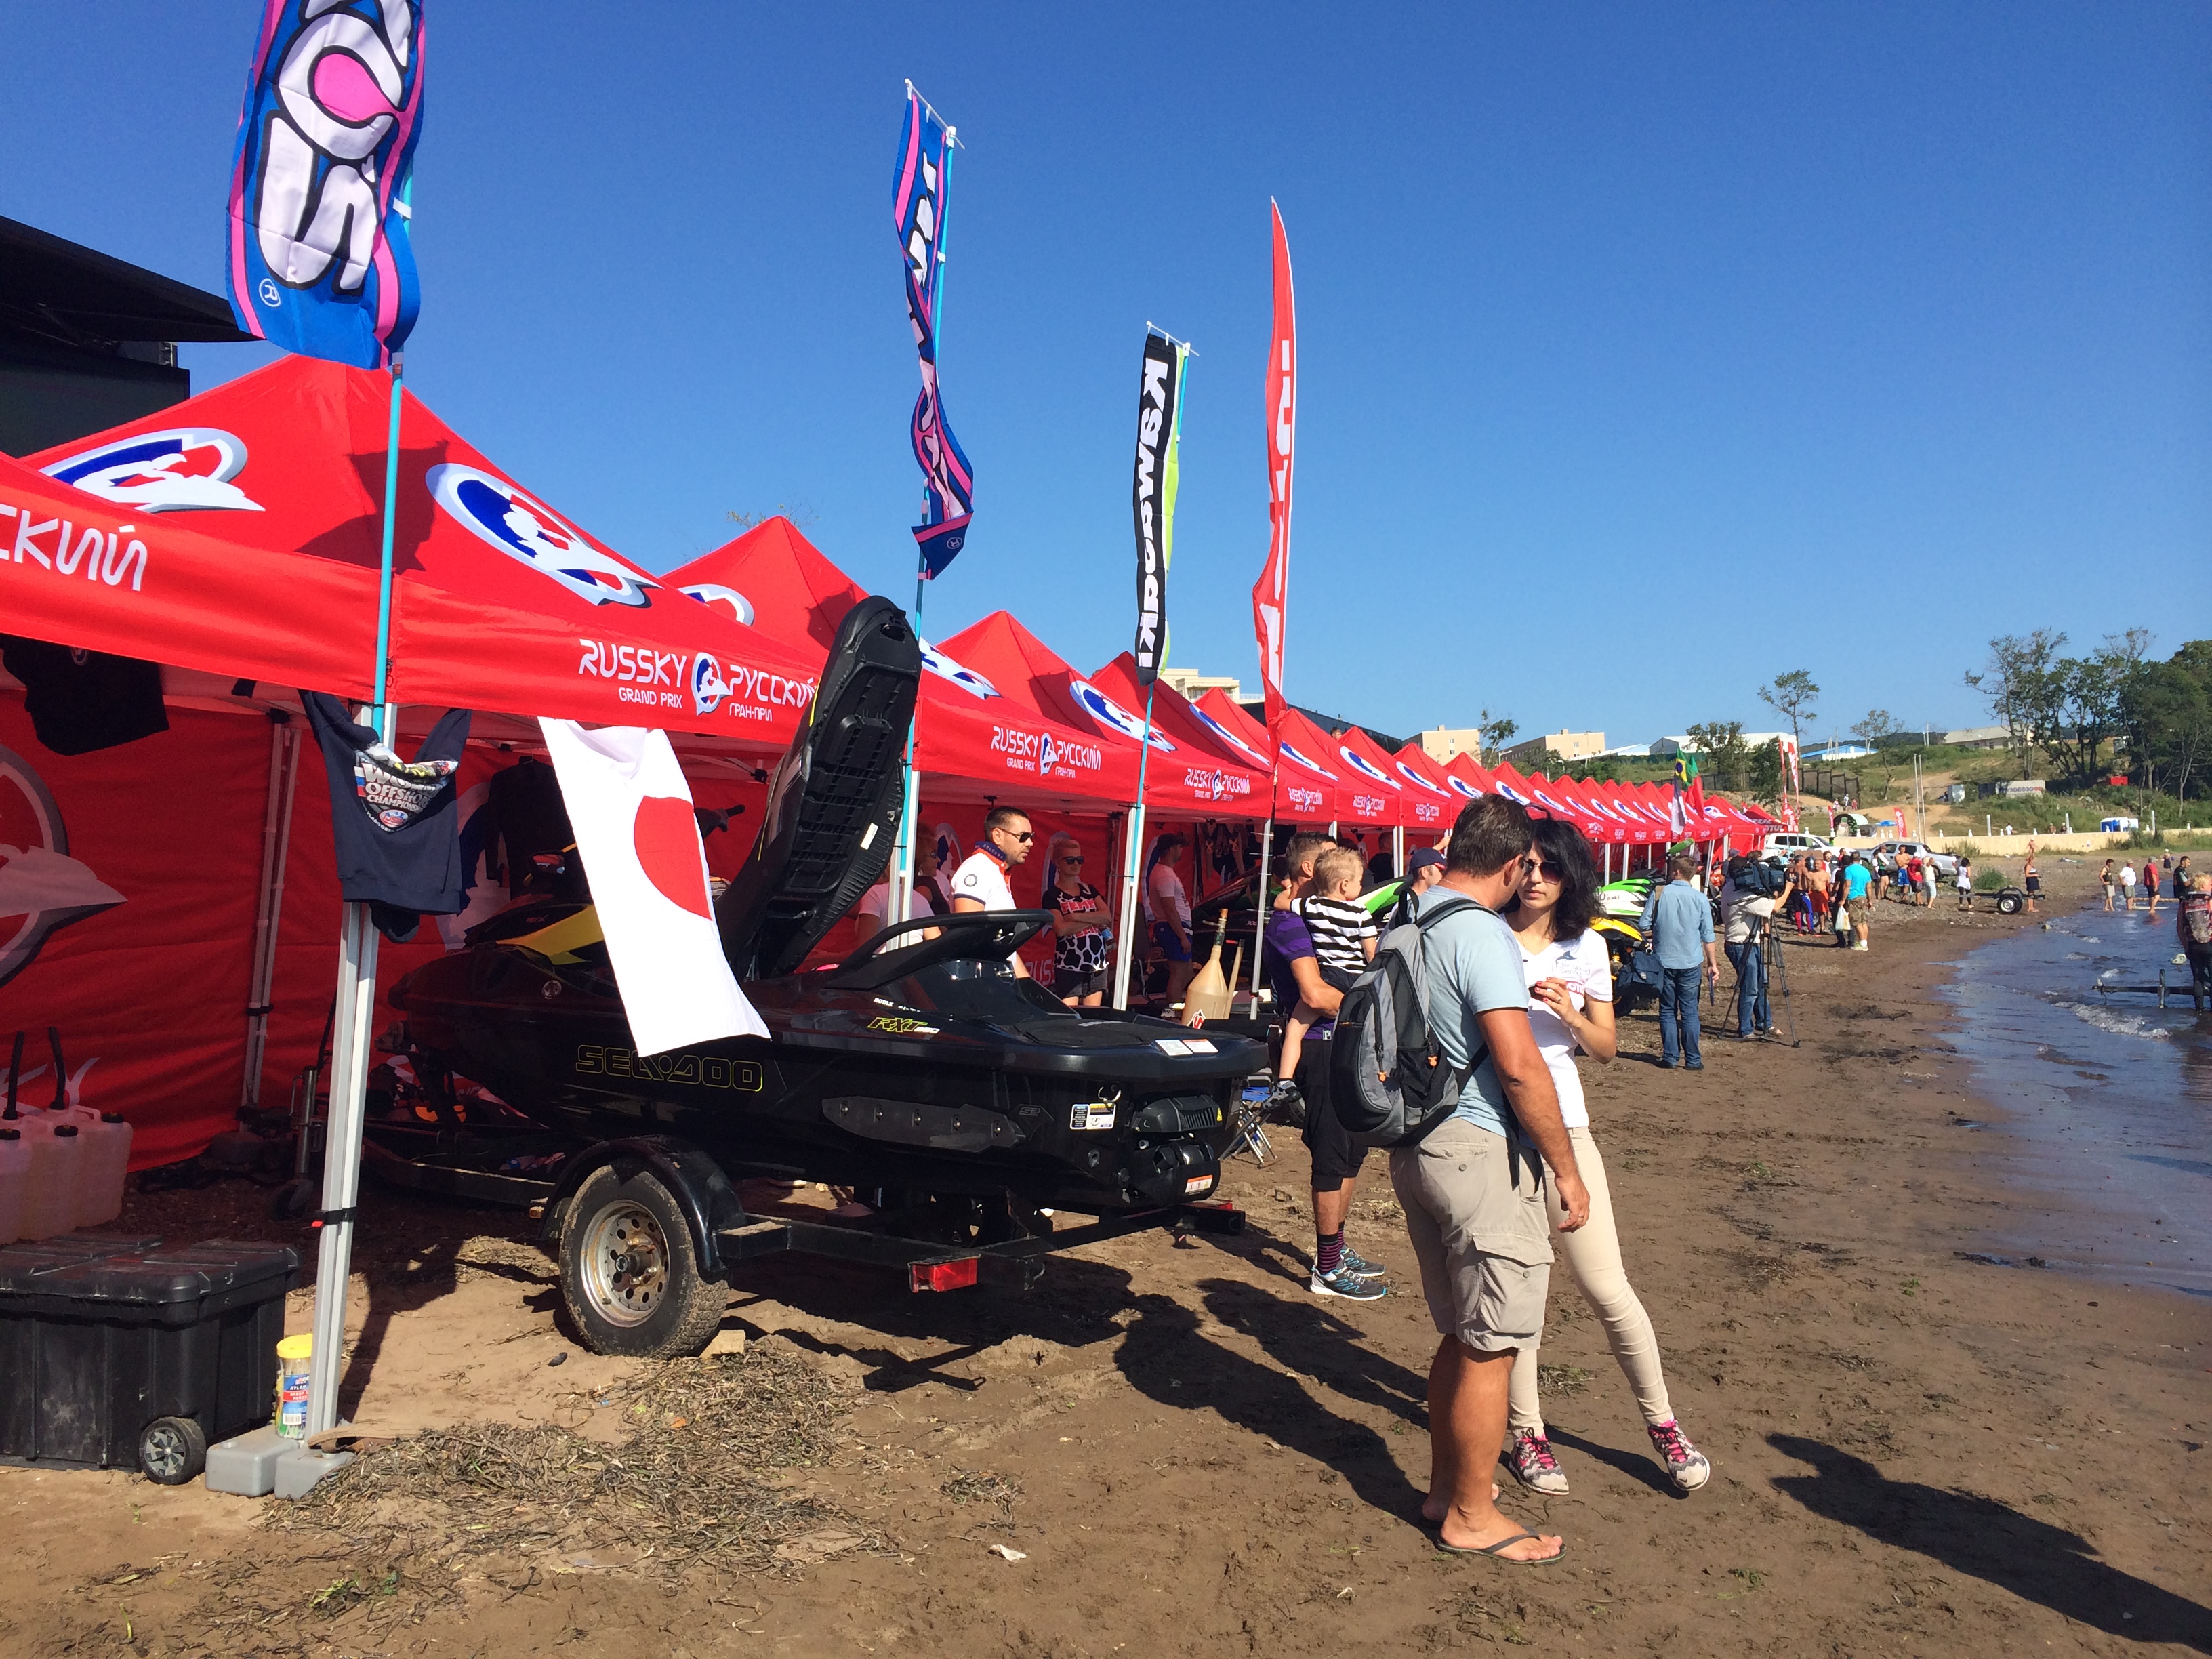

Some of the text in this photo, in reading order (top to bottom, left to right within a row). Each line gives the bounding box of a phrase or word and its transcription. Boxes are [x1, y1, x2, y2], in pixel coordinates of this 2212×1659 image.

[579, 638, 687, 688] RUSSKY
[618, 687, 683, 709] GRAND PRIX
[729, 703, 773, 722] ГРАН-ПРИ
[990, 726, 1038, 758] RUSSKY
[1006, 757, 1036, 771] GRAND PRIX
[1057, 740, 1102, 771] РУССКИЙ
[1184, 768, 1215, 790] RUSSKY
[874, 997, 894, 1007] ROTAX
